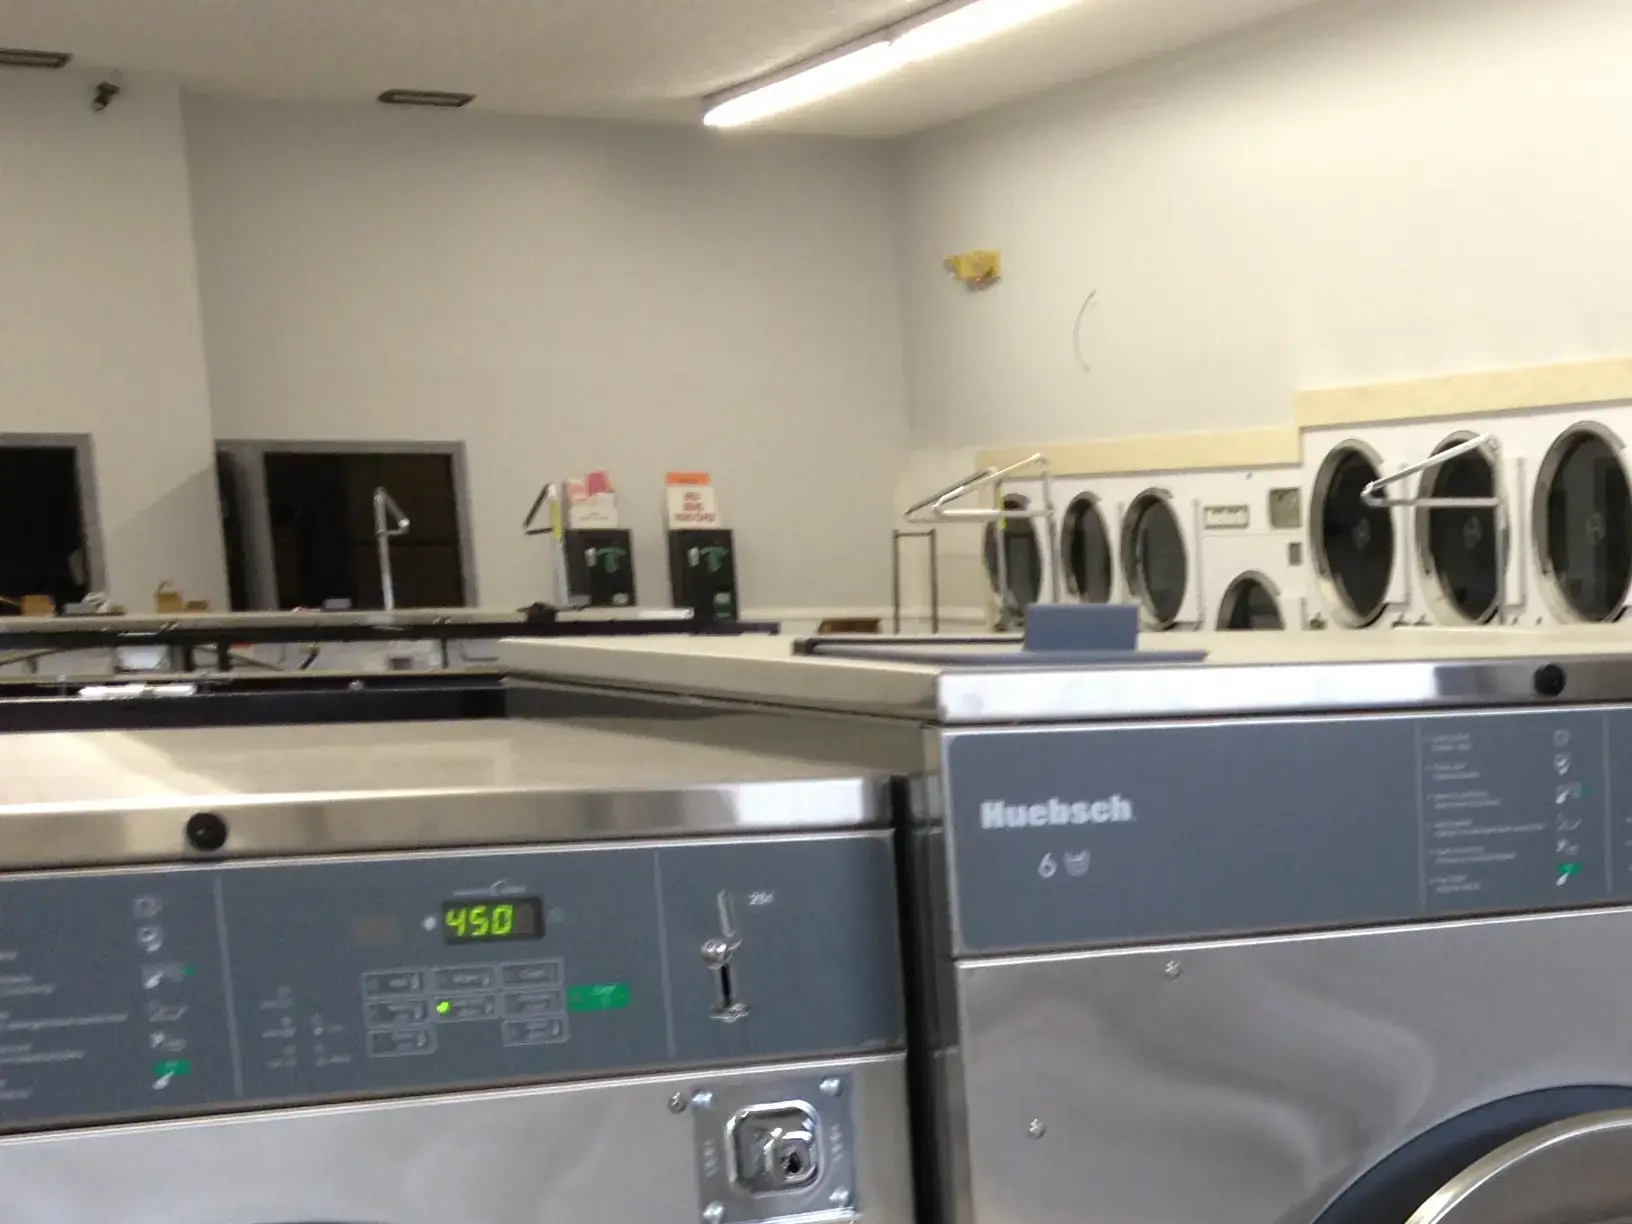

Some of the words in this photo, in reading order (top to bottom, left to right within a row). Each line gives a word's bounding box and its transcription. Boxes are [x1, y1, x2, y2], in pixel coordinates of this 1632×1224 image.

[980, 794, 1133, 829] Huebsch
[1038, 852, 1057, 878] 6
[445, 905, 514, 937] 450
